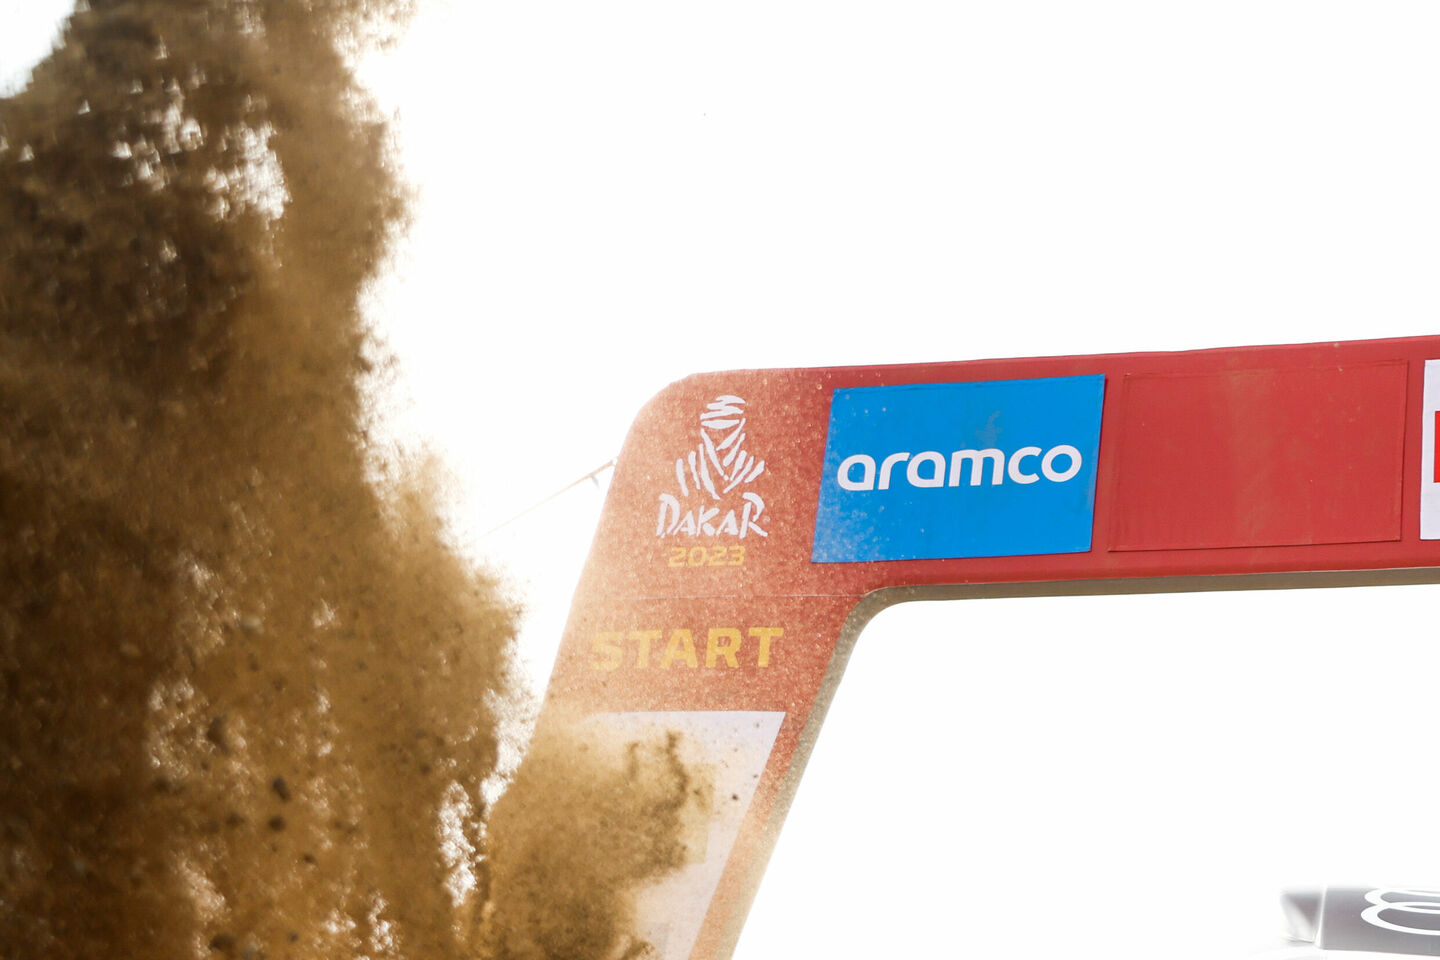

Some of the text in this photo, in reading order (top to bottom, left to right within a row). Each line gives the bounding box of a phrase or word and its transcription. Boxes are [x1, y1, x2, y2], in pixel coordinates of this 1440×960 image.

[836, 444, 1082, 491] aramco
[656, 492, 768, 540] DAKAR
[668, 545, 746, 567] 2023
[591, 626, 784, 670] START
